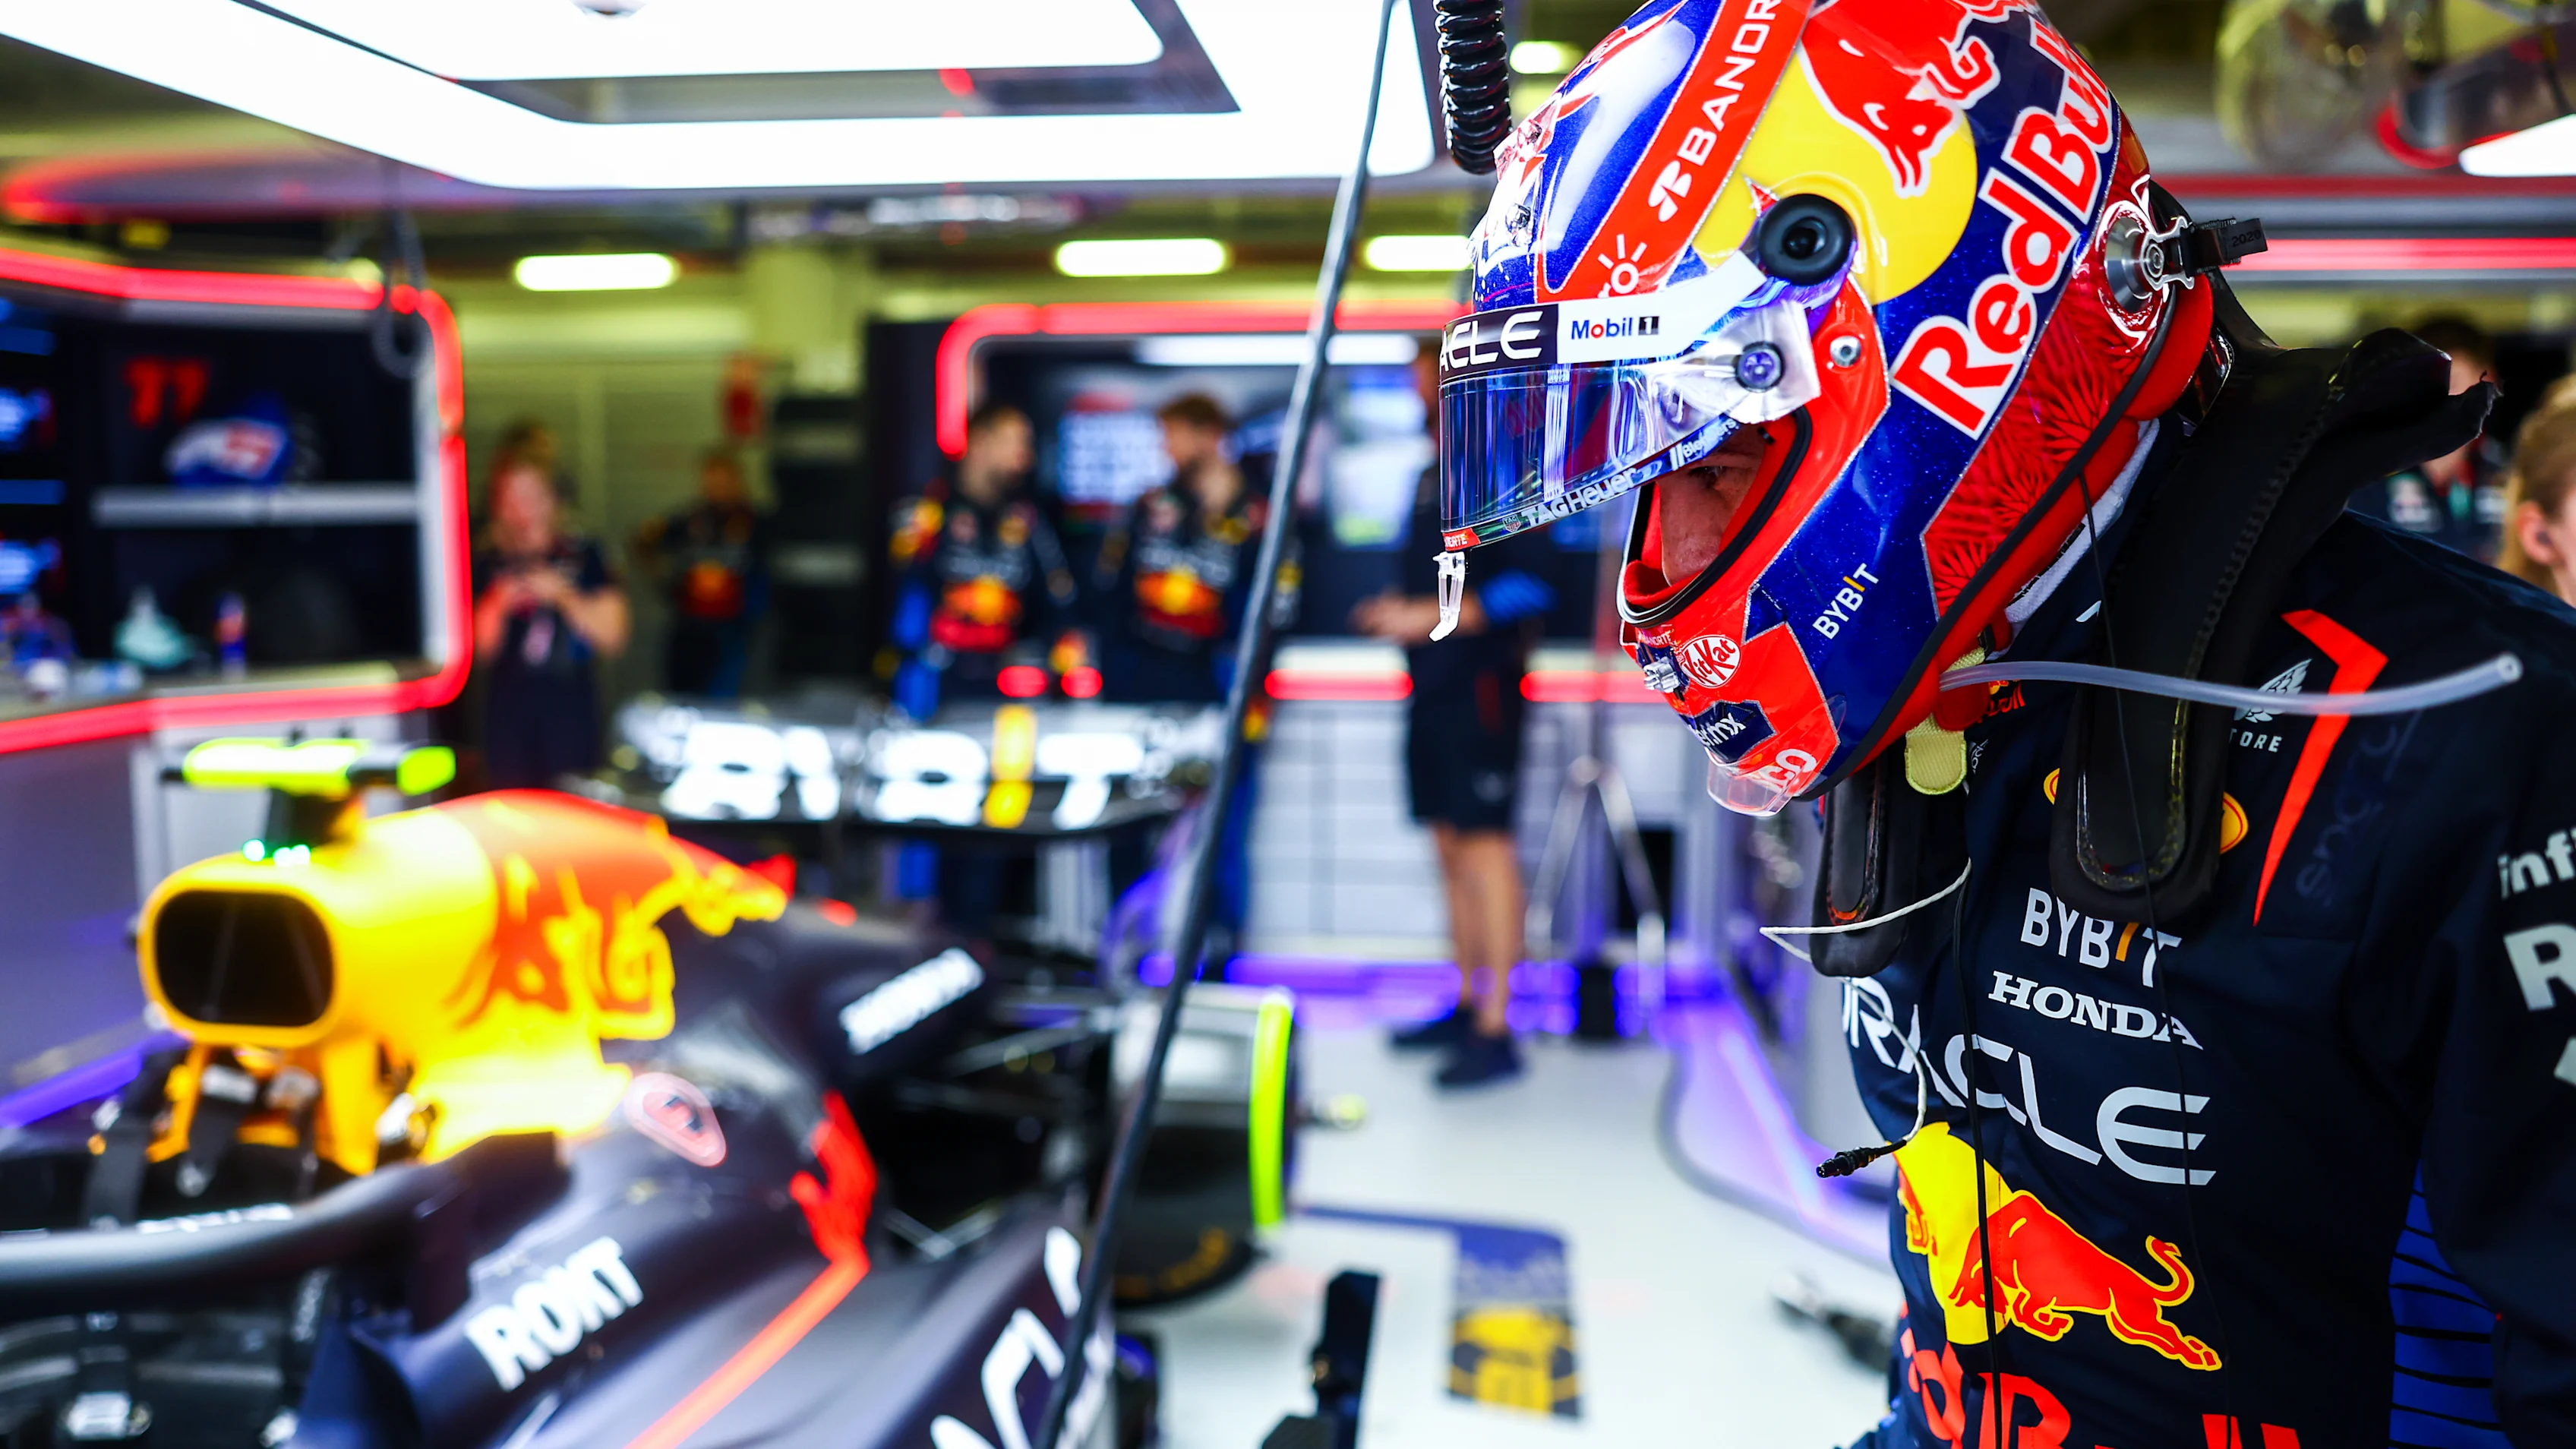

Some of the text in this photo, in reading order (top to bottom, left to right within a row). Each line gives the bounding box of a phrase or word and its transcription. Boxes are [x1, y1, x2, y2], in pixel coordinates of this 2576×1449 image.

[1891, 14, 2113, 439] Red Bull
[2231, 229, 2262, 248] 2020
[1571, 317, 1633, 340] Mobil
[1812, 562, 1880, 639] BYBIT
[2020, 887, 2183, 988] BYBIT
[1987, 970, 2205, 1050] HONDA
